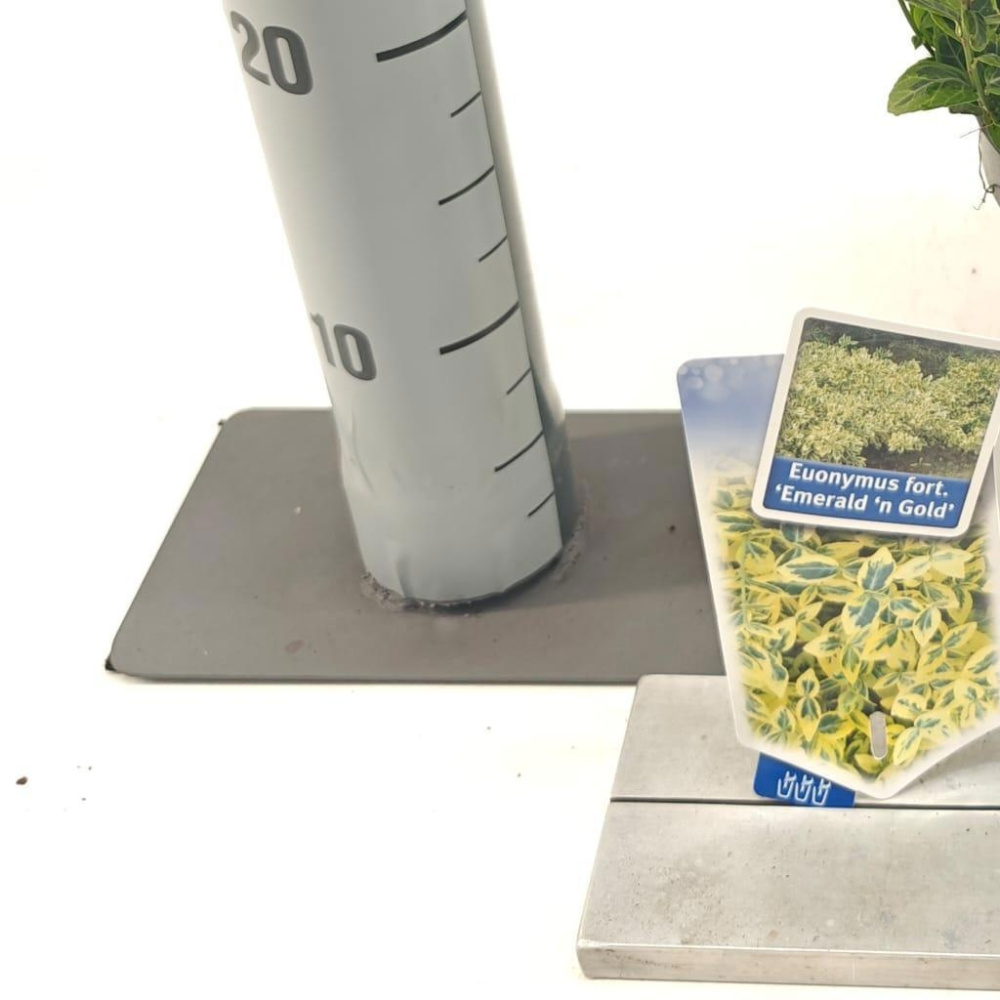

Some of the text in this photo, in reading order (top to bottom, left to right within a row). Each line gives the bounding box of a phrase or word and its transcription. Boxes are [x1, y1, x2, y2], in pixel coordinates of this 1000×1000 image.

[230, 10, 313, 95] 20
[310, 312, 377, 381] 10
[775, 483, 868, 511] ‘Emerald
[898, 500, 955, 519] Gold’
[789, 462, 949, 497] Euonymus fort.
